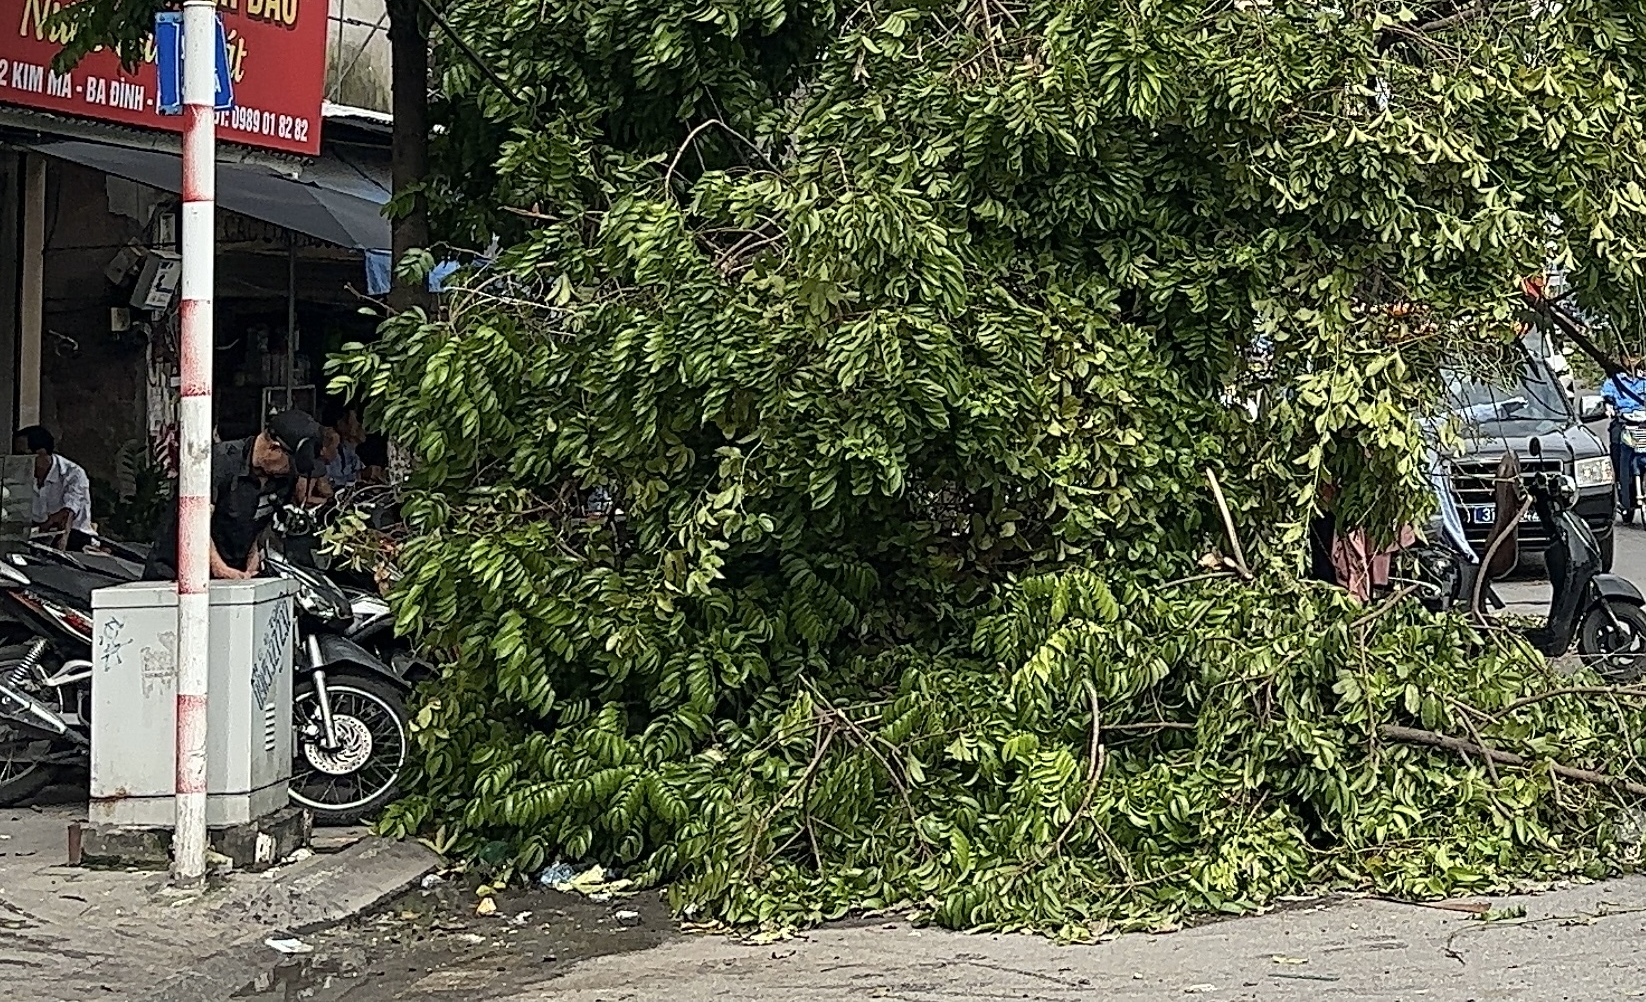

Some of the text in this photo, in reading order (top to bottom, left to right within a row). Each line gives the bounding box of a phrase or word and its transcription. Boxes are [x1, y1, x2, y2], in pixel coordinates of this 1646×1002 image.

[12, 61, 43, 93] KIM
[86, 75, 106, 105] BA
[232, 105, 260, 134] 0989
[262, 111, 275, 137] 01
[278, 114, 293, 140] 82
[294, 118, 309, 143] 82
